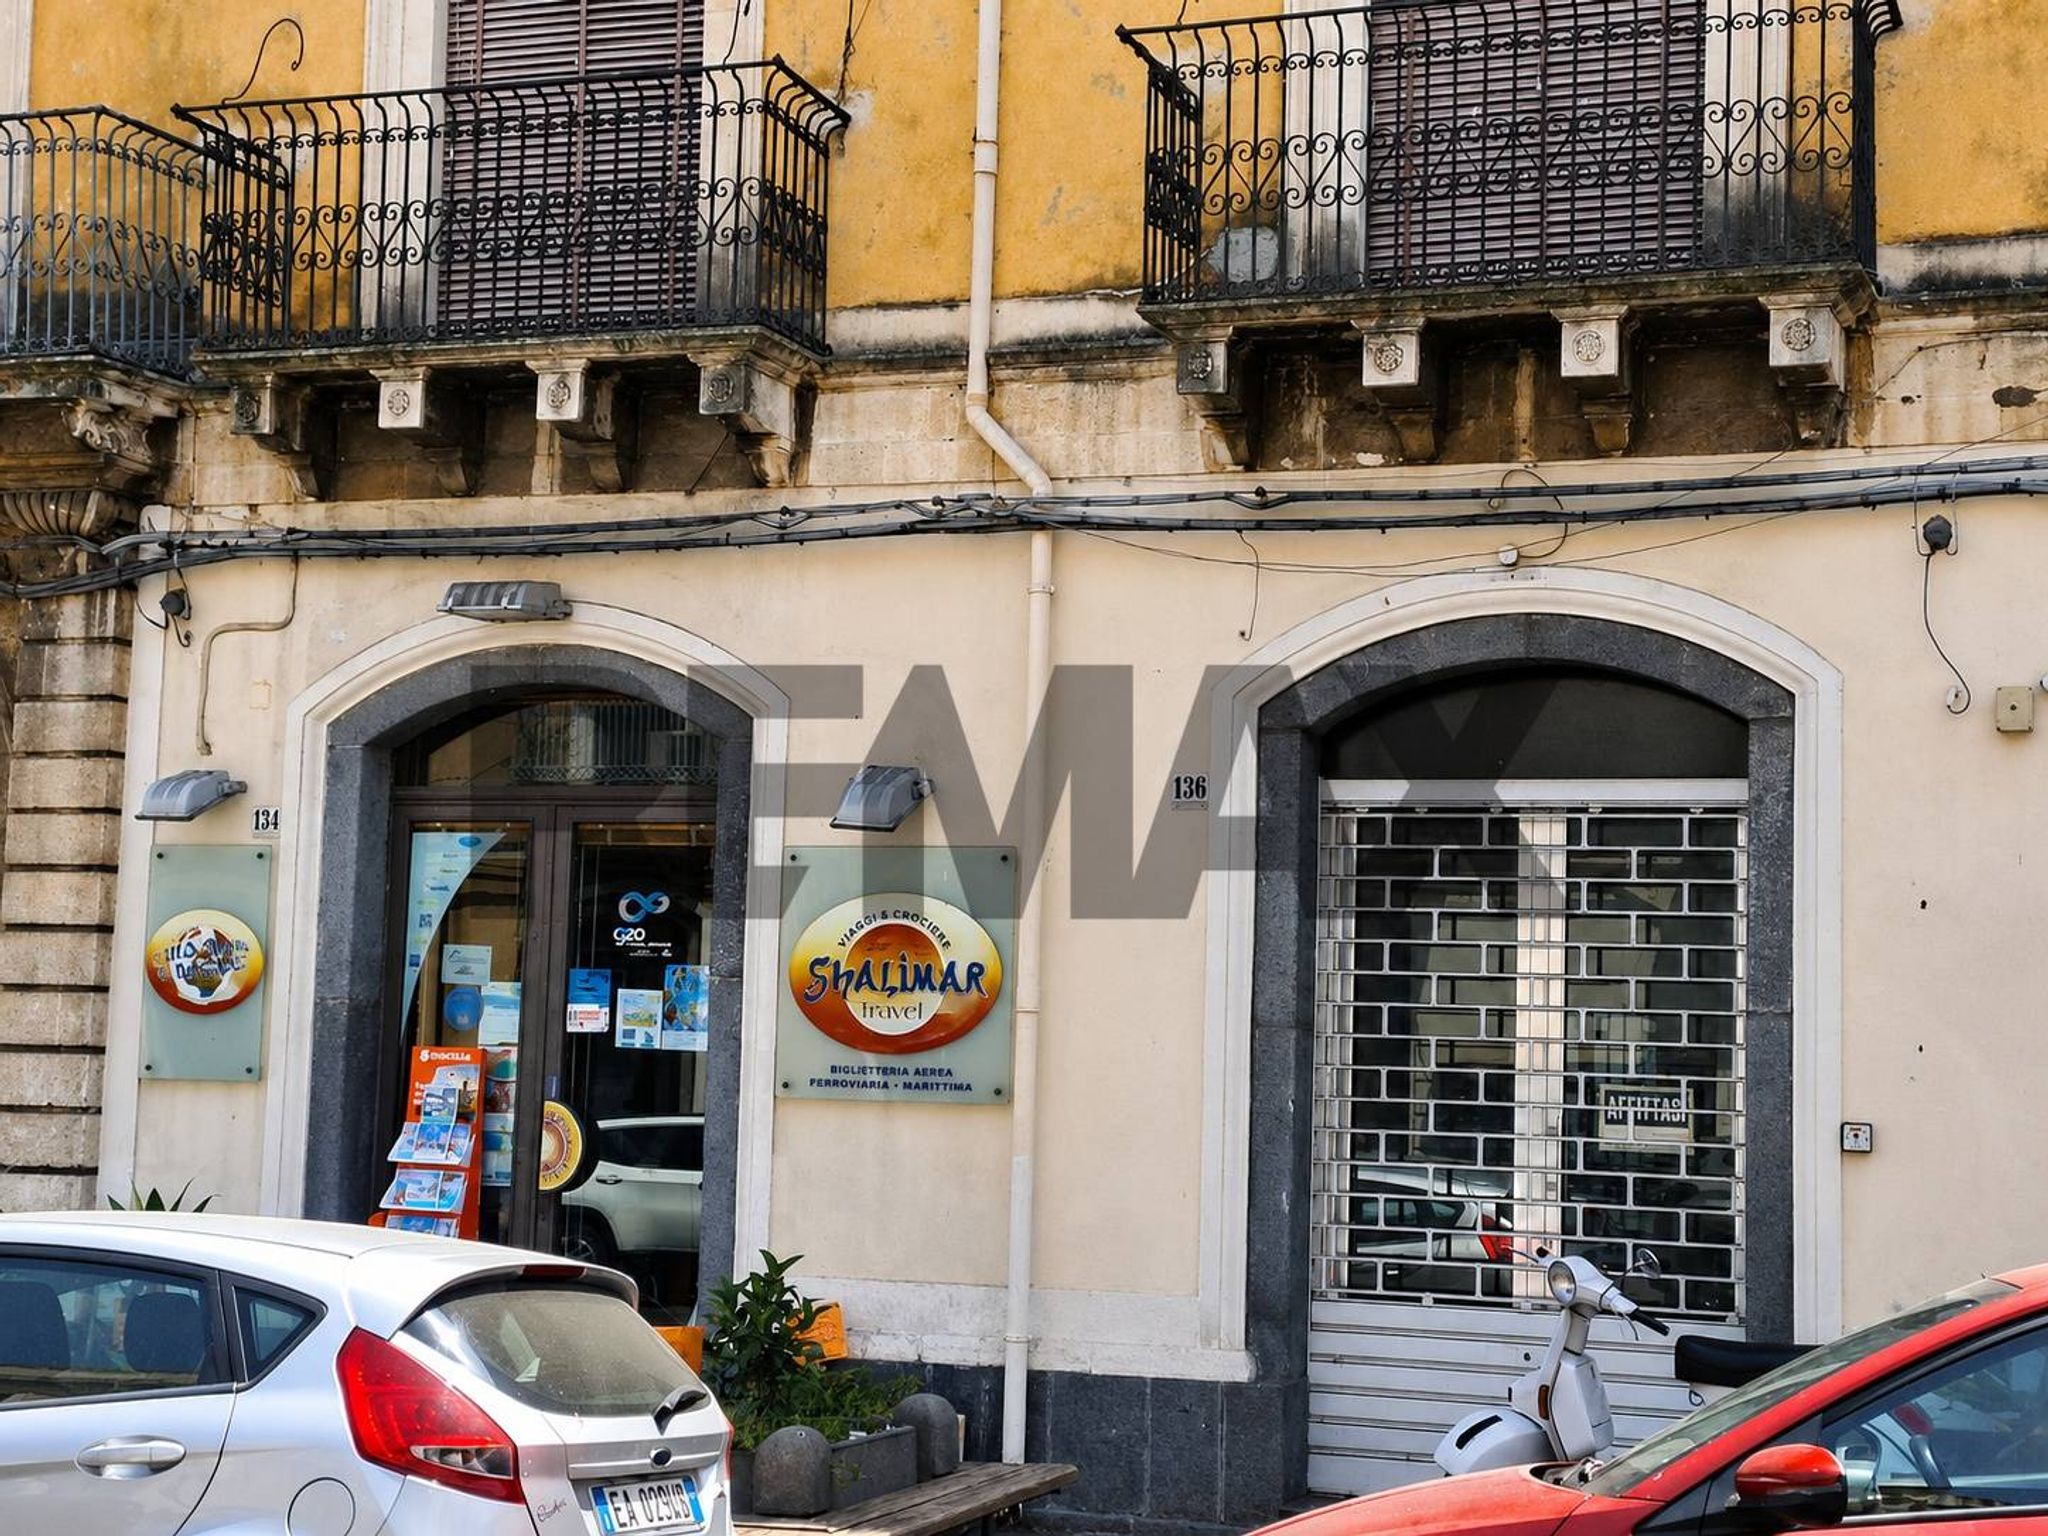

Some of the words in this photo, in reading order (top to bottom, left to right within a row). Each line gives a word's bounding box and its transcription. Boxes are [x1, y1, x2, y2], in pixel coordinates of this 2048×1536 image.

[1173, 775, 1207, 800] 136
[253, 808, 279, 831] 134
[838, 912, 878, 948] VIAGGI
[880, 909, 889, 921] &
[892, 908, 952, 950] CROCIERE
[861, 1001, 924, 1021] travel
[829, 1064, 910, 1077] BIGLIETTERIA
[913, 1067, 954, 1079] AEREA
[808, 1077, 891, 1090] FERROVIARIA
[902, 1081, 974, 1093] MARITTIMA
[609, 1489, 640, 1528] EA
